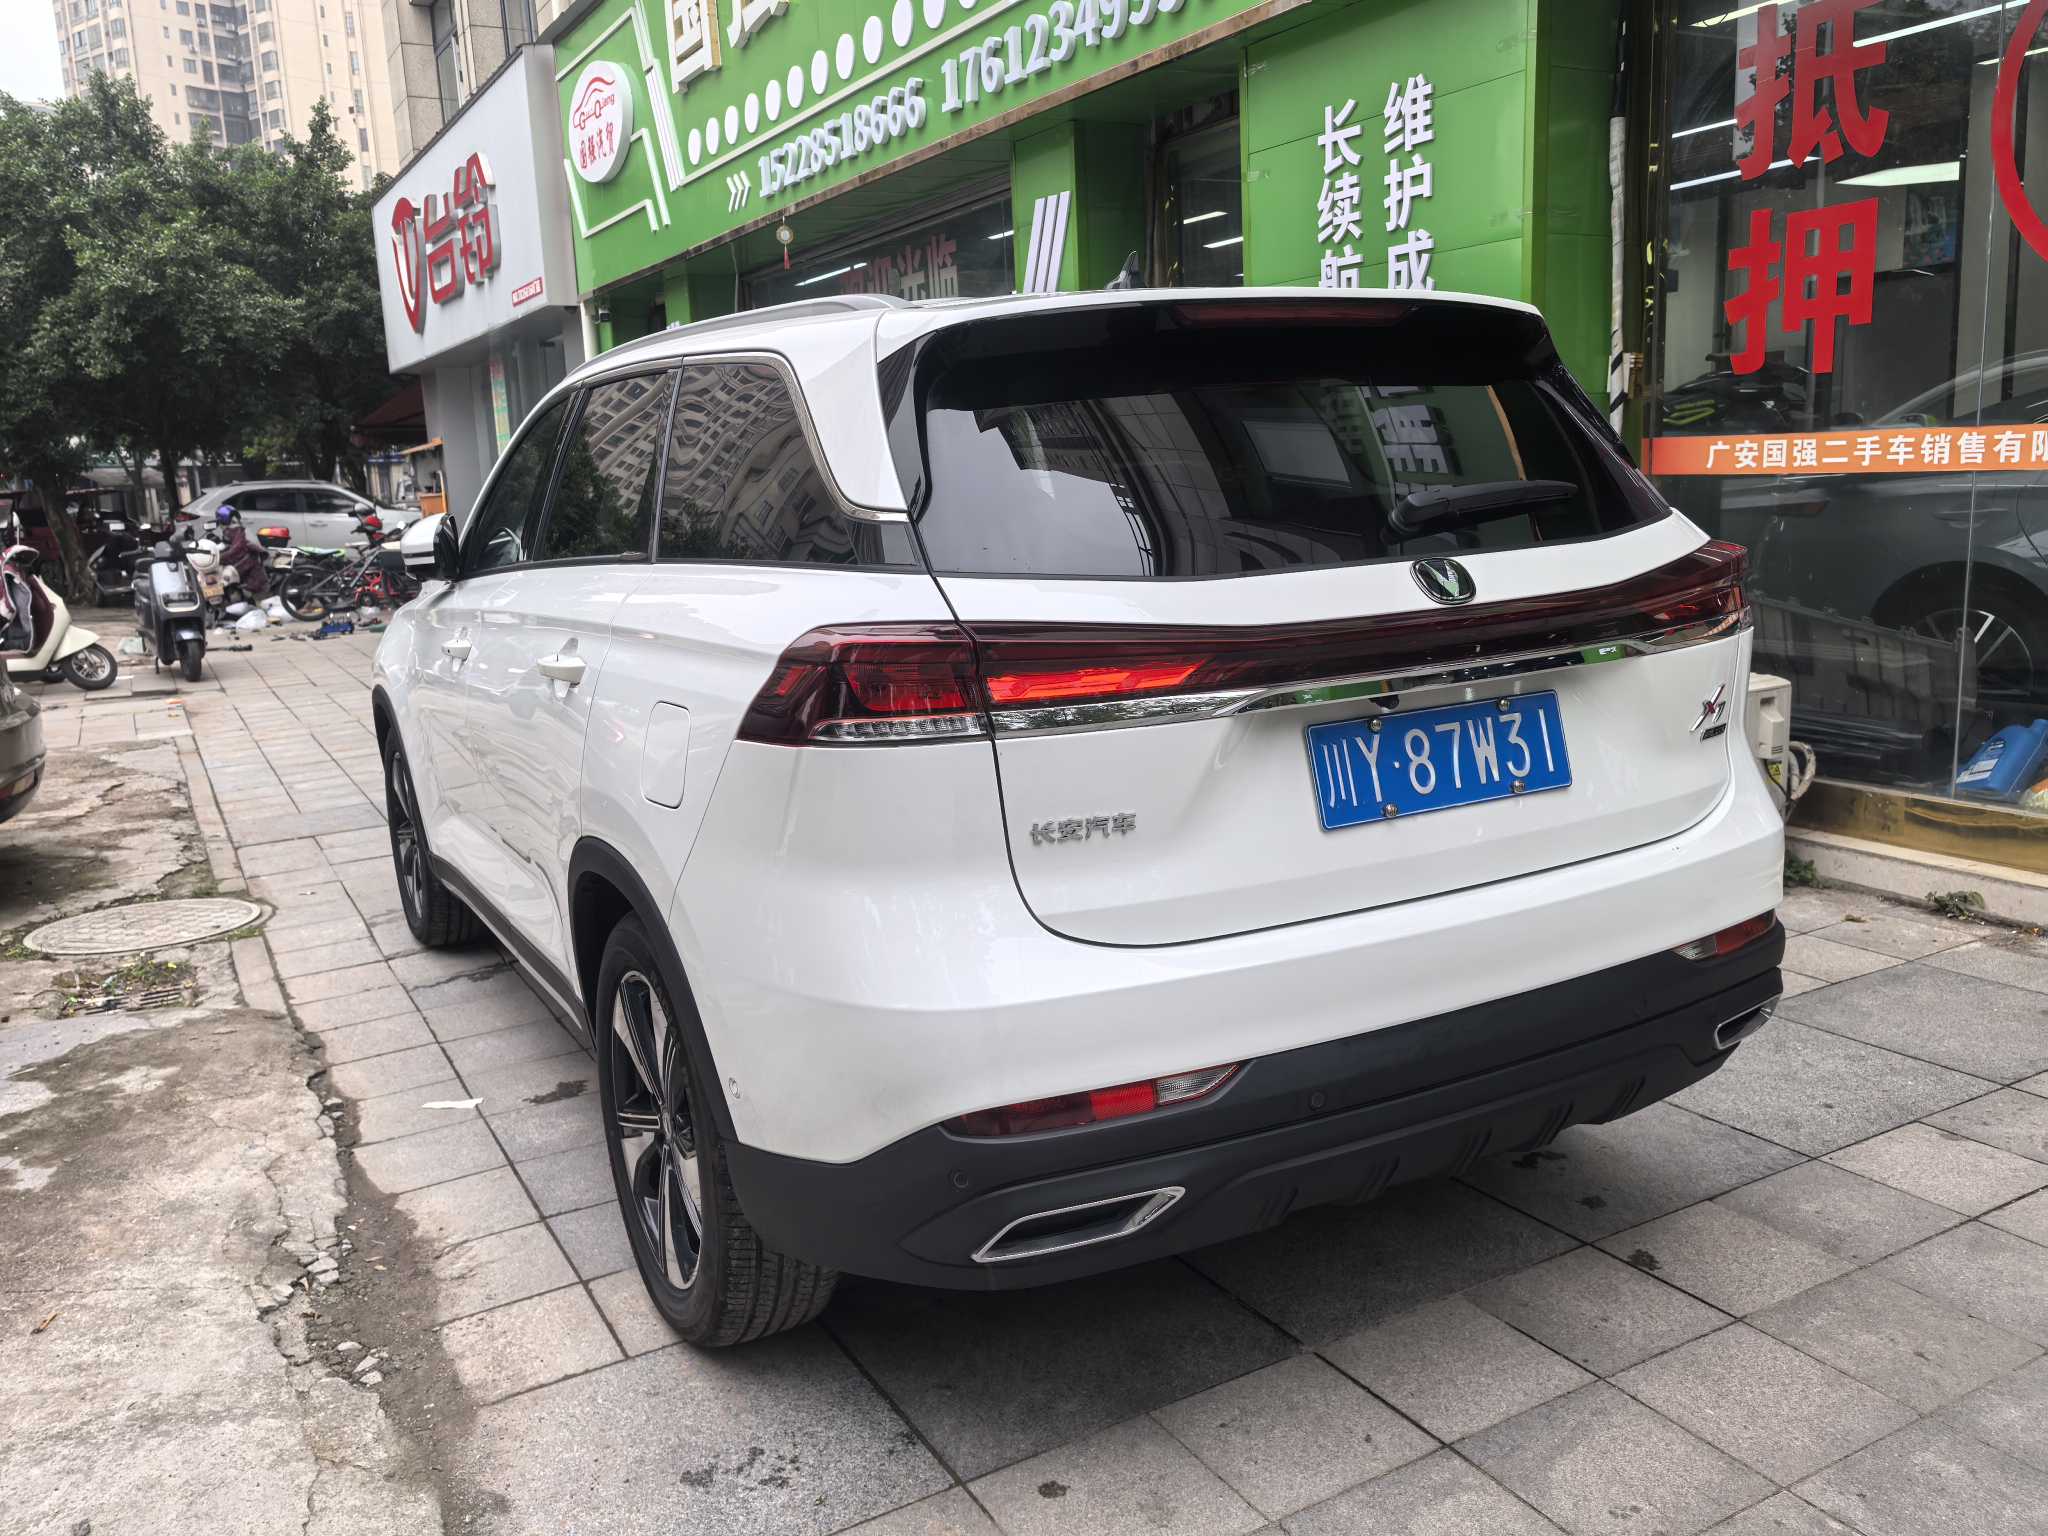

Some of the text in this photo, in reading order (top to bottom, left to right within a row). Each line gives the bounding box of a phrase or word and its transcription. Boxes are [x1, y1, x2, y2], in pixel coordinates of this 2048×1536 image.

[758, 77, 926, 199] 15228518666
[1725, 0, 1890, 375] 抵押
[424, 152, 499, 304] 台铃
[1030, 812, 1137, 846] 长安汽车
